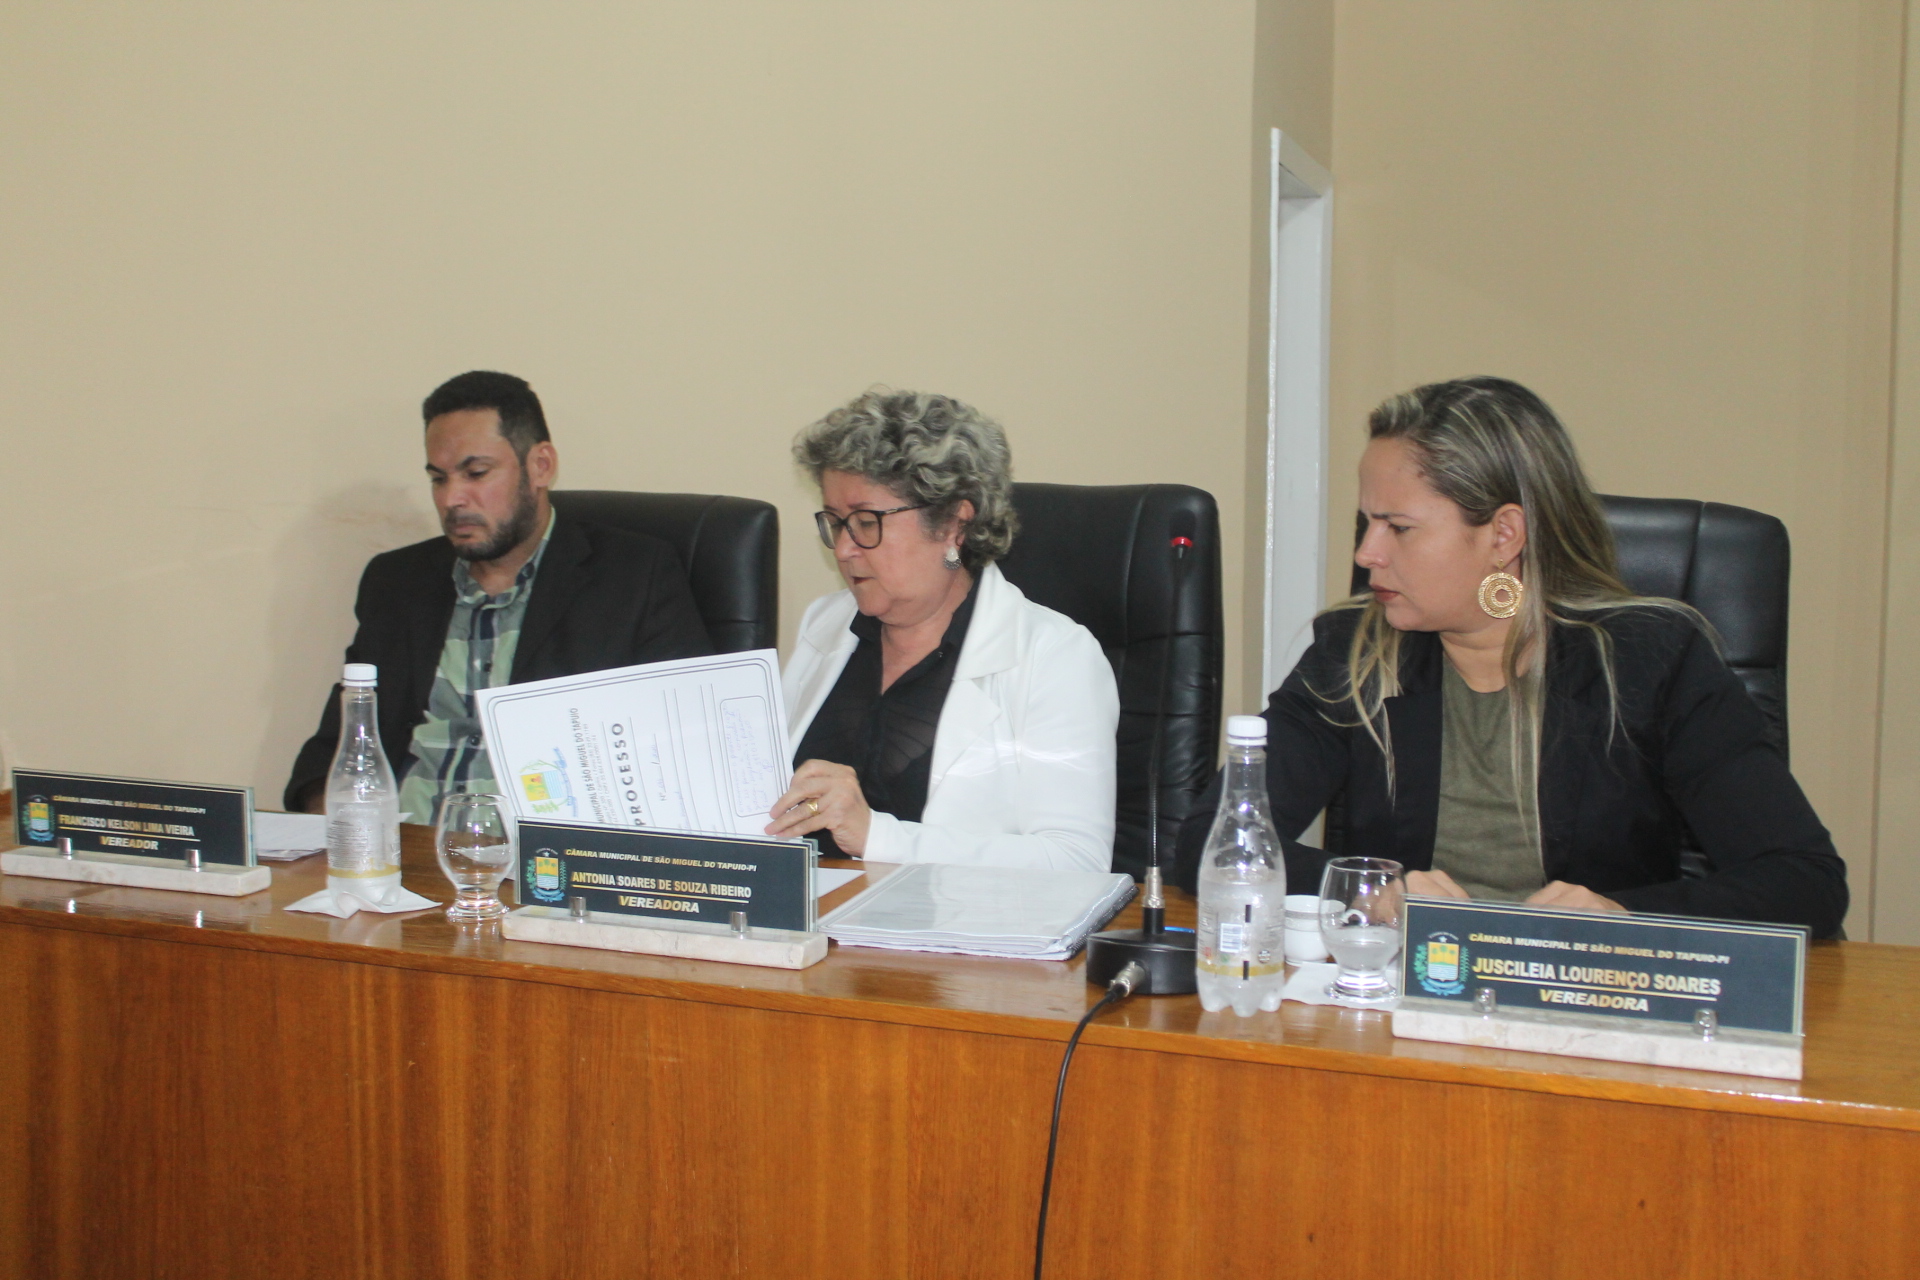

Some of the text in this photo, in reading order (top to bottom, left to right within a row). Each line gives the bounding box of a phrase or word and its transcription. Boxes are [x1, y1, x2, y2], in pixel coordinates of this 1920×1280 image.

[569, 707, 582, 731] TAPUIO
[574, 732, 584, 743] DO
[576, 743, 590, 768] MIGUEL
[581, 769, 593, 782] SÃO
[611, 723, 646, 826] PROCESSO
[586, 783, 596, 792] DE
[138, 803, 162, 811] MIGUEL
[588, 792, 606, 823] MUNICIPAL
[58, 814, 195, 837] FRANCISCO KELSON LIMA VIEIRA
[100, 835, 158, 850] VEREADOR
[565, 848, 598, 858] CÂMARA
[599, 852, 640, 862] MUNICIPAL
[642, 855, 653, 863] DE
[654, 855, 671, 865] SÃO
[672, 858, 702, 867] MIGUEL
[704, 860, 716, 868] DO
[717, 862, 757, 872] TAPUIO-PI
[571, 872, 752, 899] ANTONIA SOARES DE SOUZA RIBEIRO
[618, 895, 700, 914] VEREADORA
[1468, 932, 1513, 945] CÂMARA
[1514, 937, 1571, 951] MUNICIPAL
[1573, 942, 1588, 951] DE
[1589, 942, 1612, 954] SÃO
[1614, 945, 1655, 958] MIGUEL
[1657, 950, 1674, 960] DO
[1676, 951, 1730, 965] TAPUIO-PI
[1472, 957, 1721, 996] JUSCILEIA LOURENÇO SOARES
[1539, 989, 1649, 1012] VEREADORA
